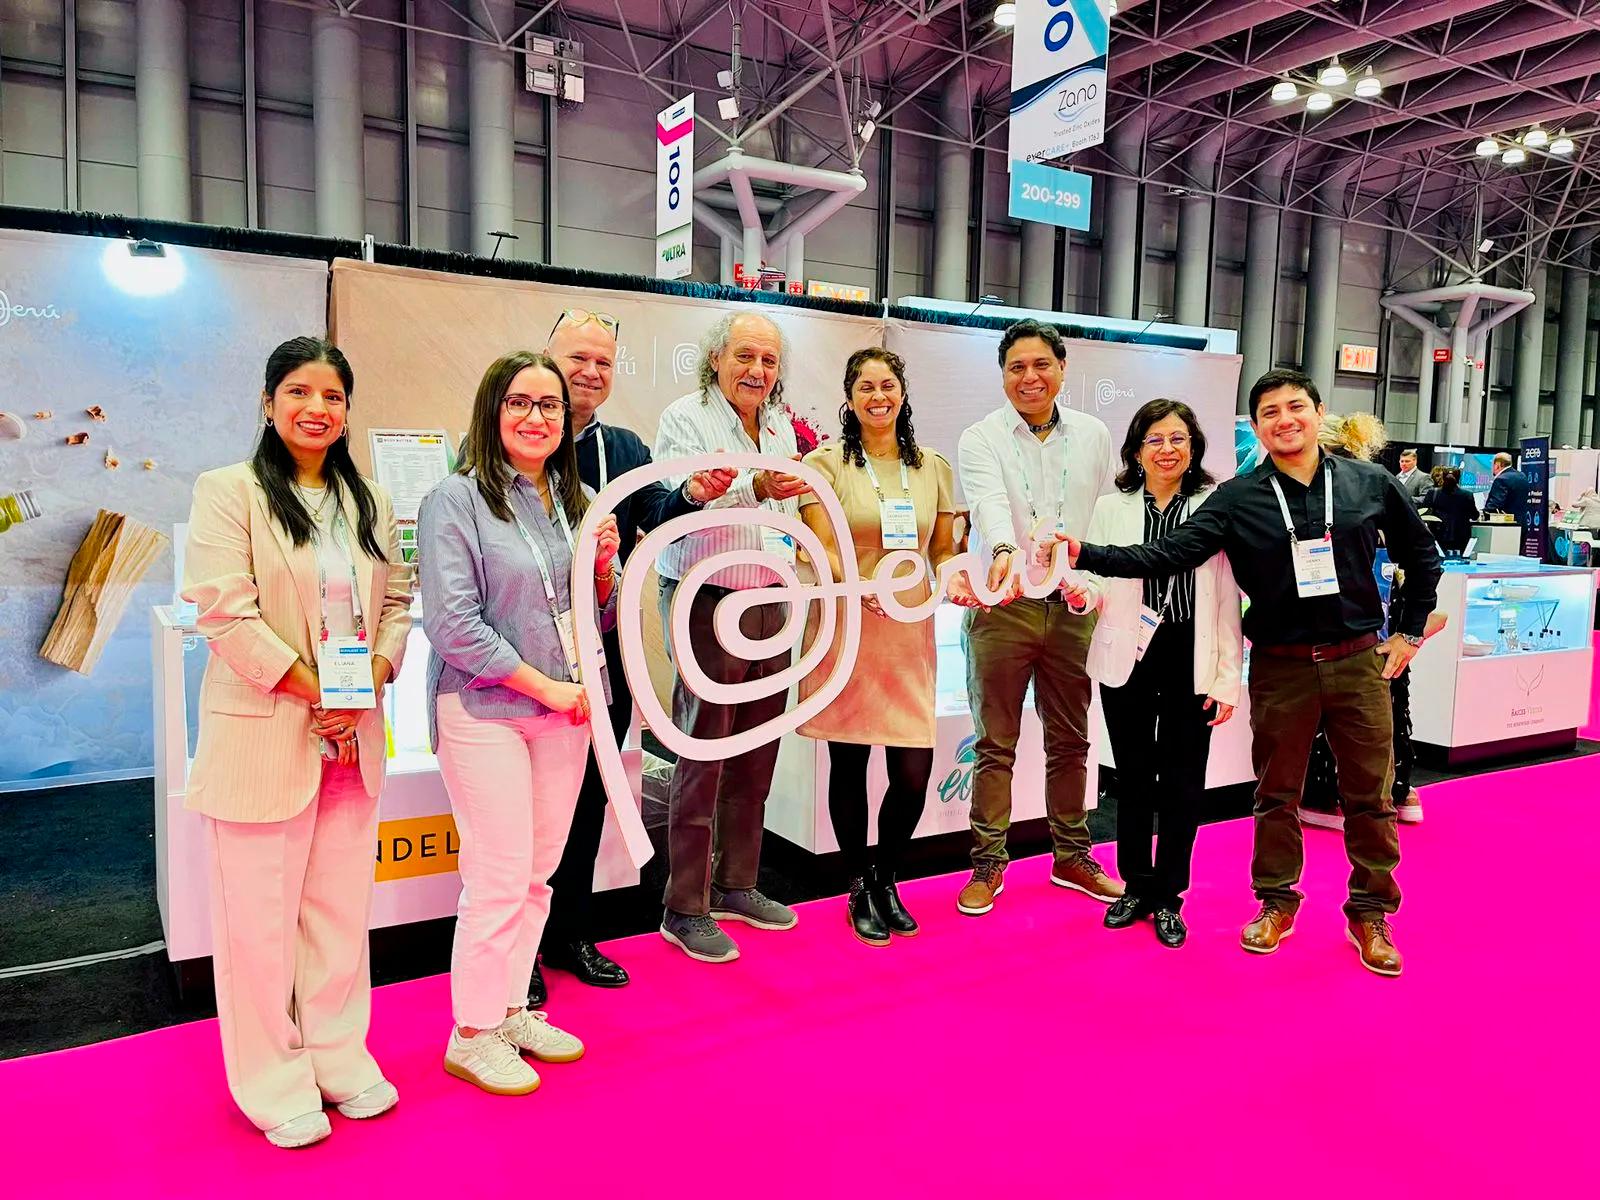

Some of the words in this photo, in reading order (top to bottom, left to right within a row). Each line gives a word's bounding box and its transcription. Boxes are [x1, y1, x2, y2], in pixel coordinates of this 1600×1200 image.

[1058, 84, 1097, 111] Zano
[669, 146, 680, 210] 100
[1021, 183, 1081, 209] 200-299
